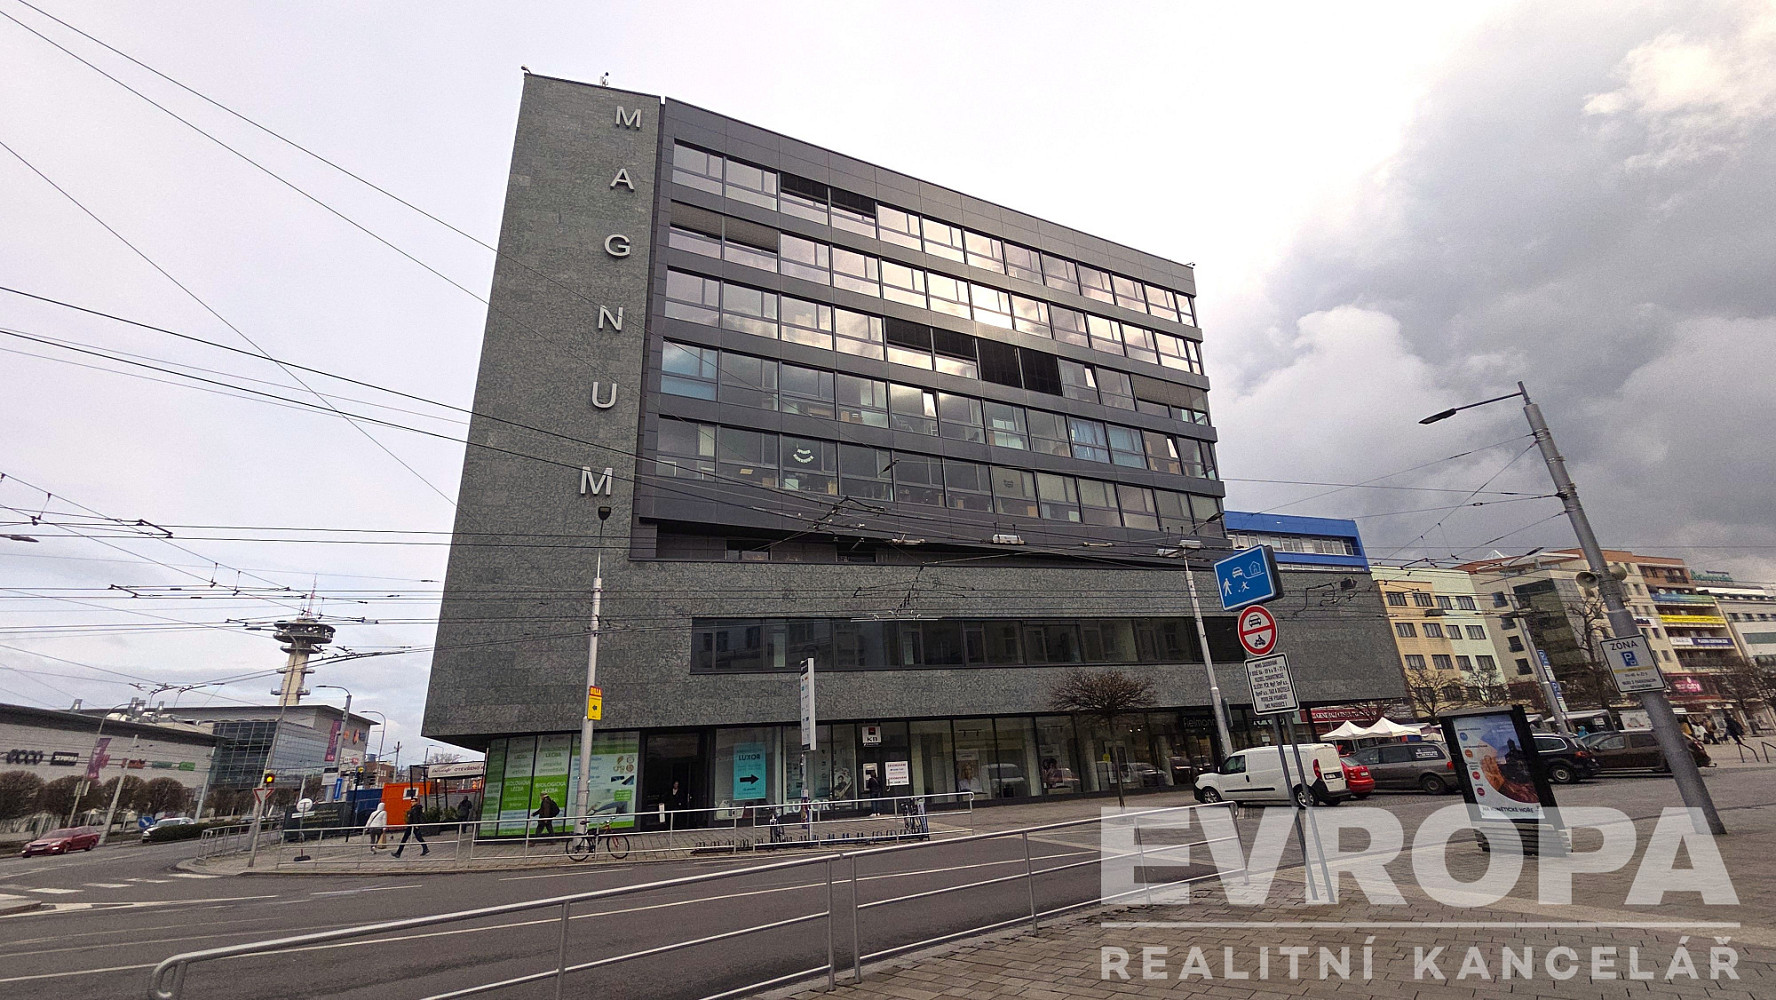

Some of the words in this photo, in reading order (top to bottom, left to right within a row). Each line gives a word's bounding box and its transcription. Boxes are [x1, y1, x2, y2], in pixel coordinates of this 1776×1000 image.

[578, 104, 643, 497] MAGNUM
[1609, 640, 1639, 651] ZÓNA
[738, 753, 761, 761] LUXOR
[786, 799, 830, 813] LUOR
